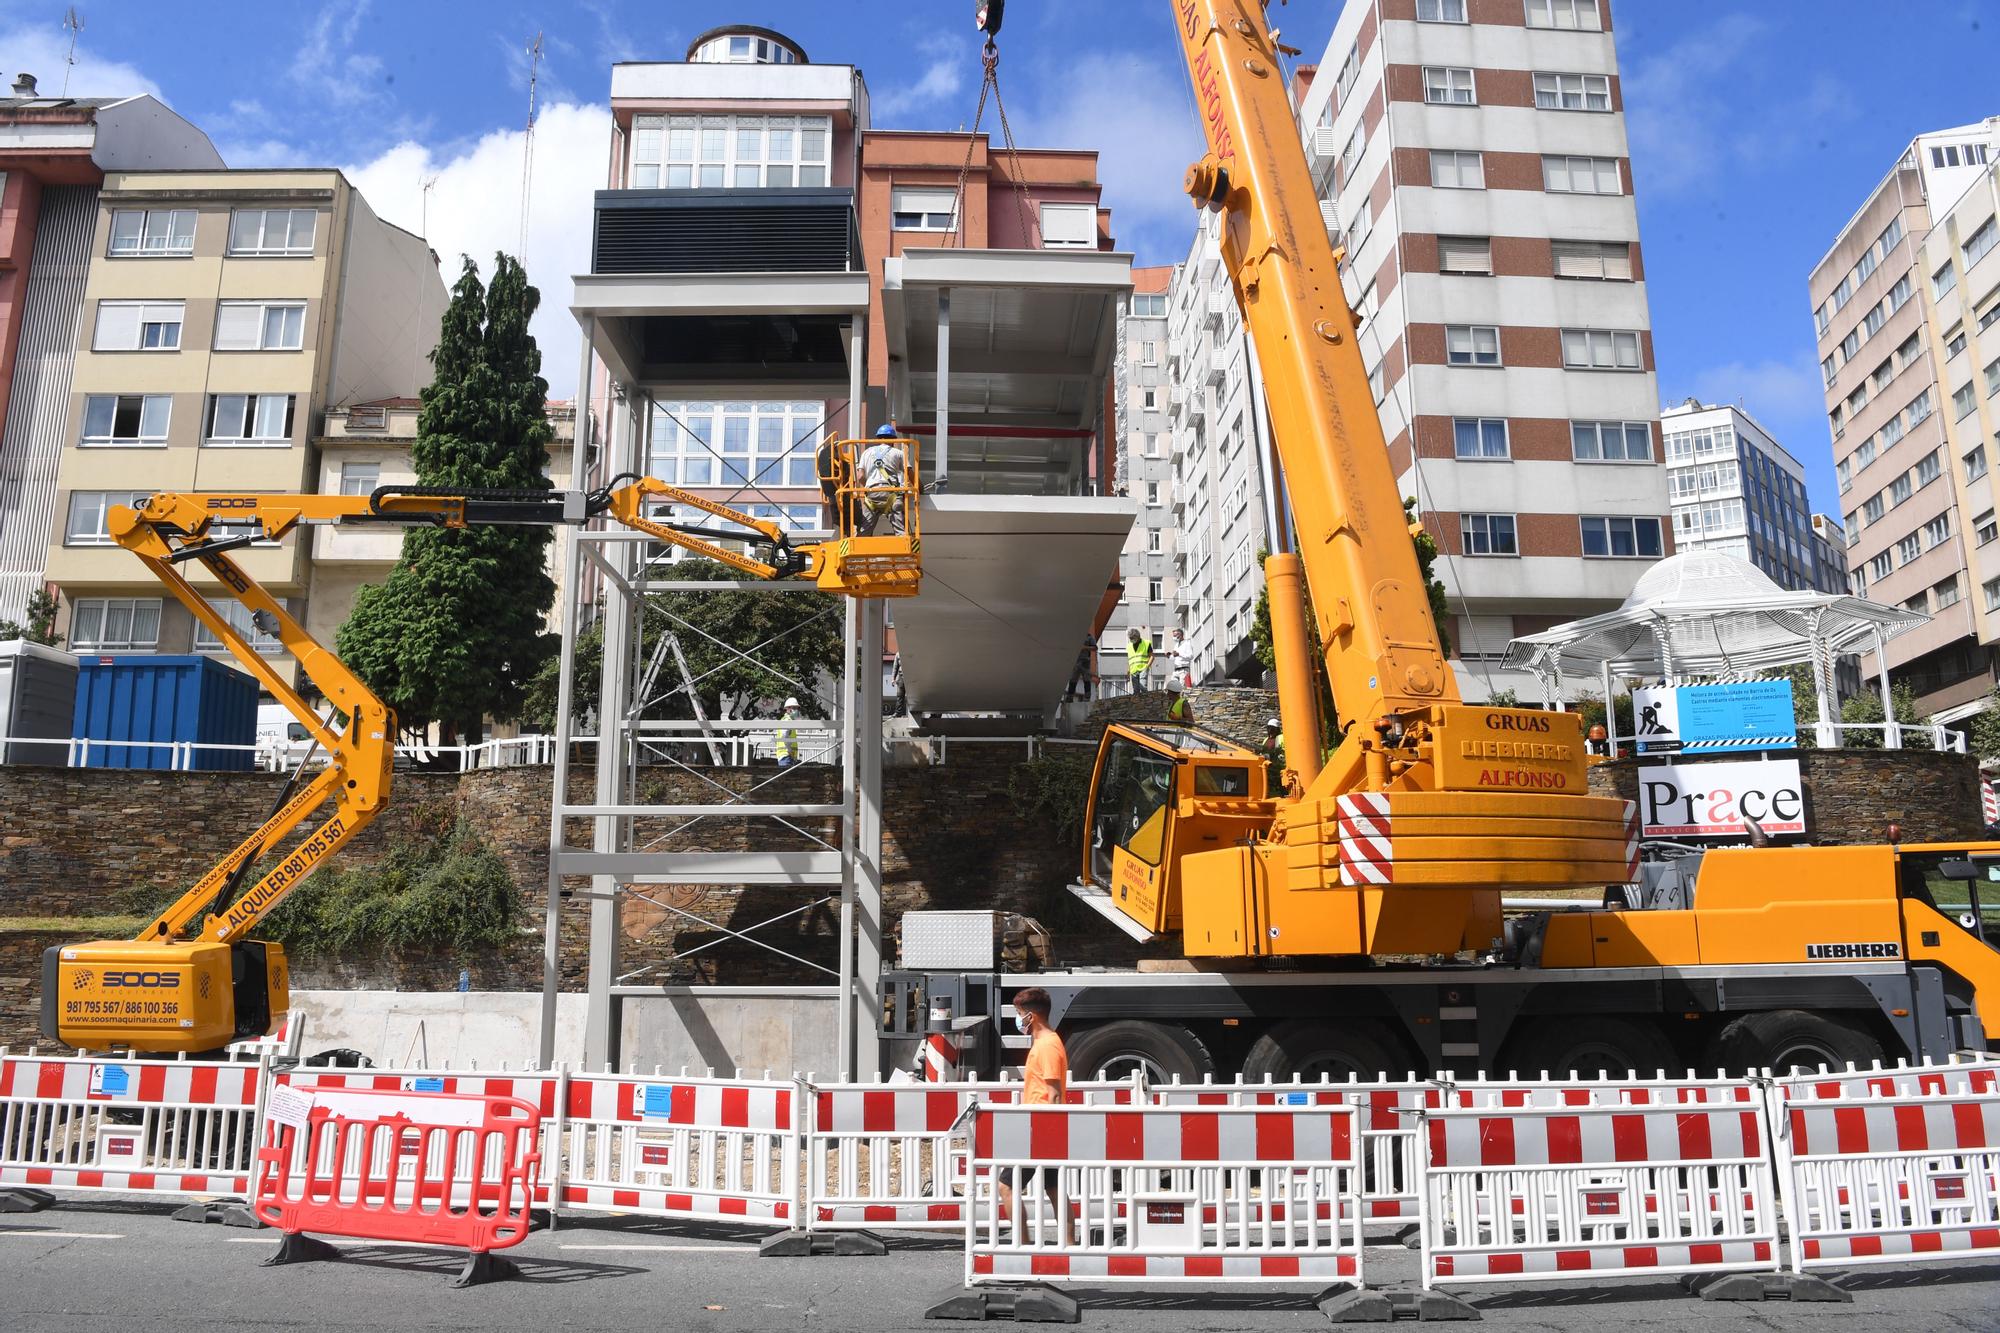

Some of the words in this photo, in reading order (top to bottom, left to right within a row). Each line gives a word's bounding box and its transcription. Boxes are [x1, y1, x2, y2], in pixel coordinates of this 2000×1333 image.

[207, 498, 257, 508] SOOS
[670, 488, 712, 509] ALQUILER
[712, 504, 726, 514] 981
[726, 509, 741, 519] 795
[742, 515, 756, 524] 567
[635, 518, 759, 569] www.soosmaquinaria.com
[1486, 713, 1550, 732] GRUAS
[1461, 740, 1571, 760] LIEBHERR
[1478, 768, 1566, 788] ALFONSO
[1641, 781, 1801, 825] Prace
[191, 786, 314, 897] www.soosmaquinaria.com
[228, 871, 289, 929] ALQUILER
[283, 855, 307, 879] 981
[302, 837, 327, 862] 795
[323, 818, 347, 844] 567
[1807, 943, 1899, 958] LIEBHERR
[102, 971, 181, 988] SOOS
[66, 1001, 82, 1013] 981
[85, 1001, 100, 1013] 795
[144, 1002, 160, 1014] 100
[161, 1002, 178, 1014] 366
[66, 1015, 177, 1024] www.soosmaquinaria.com
